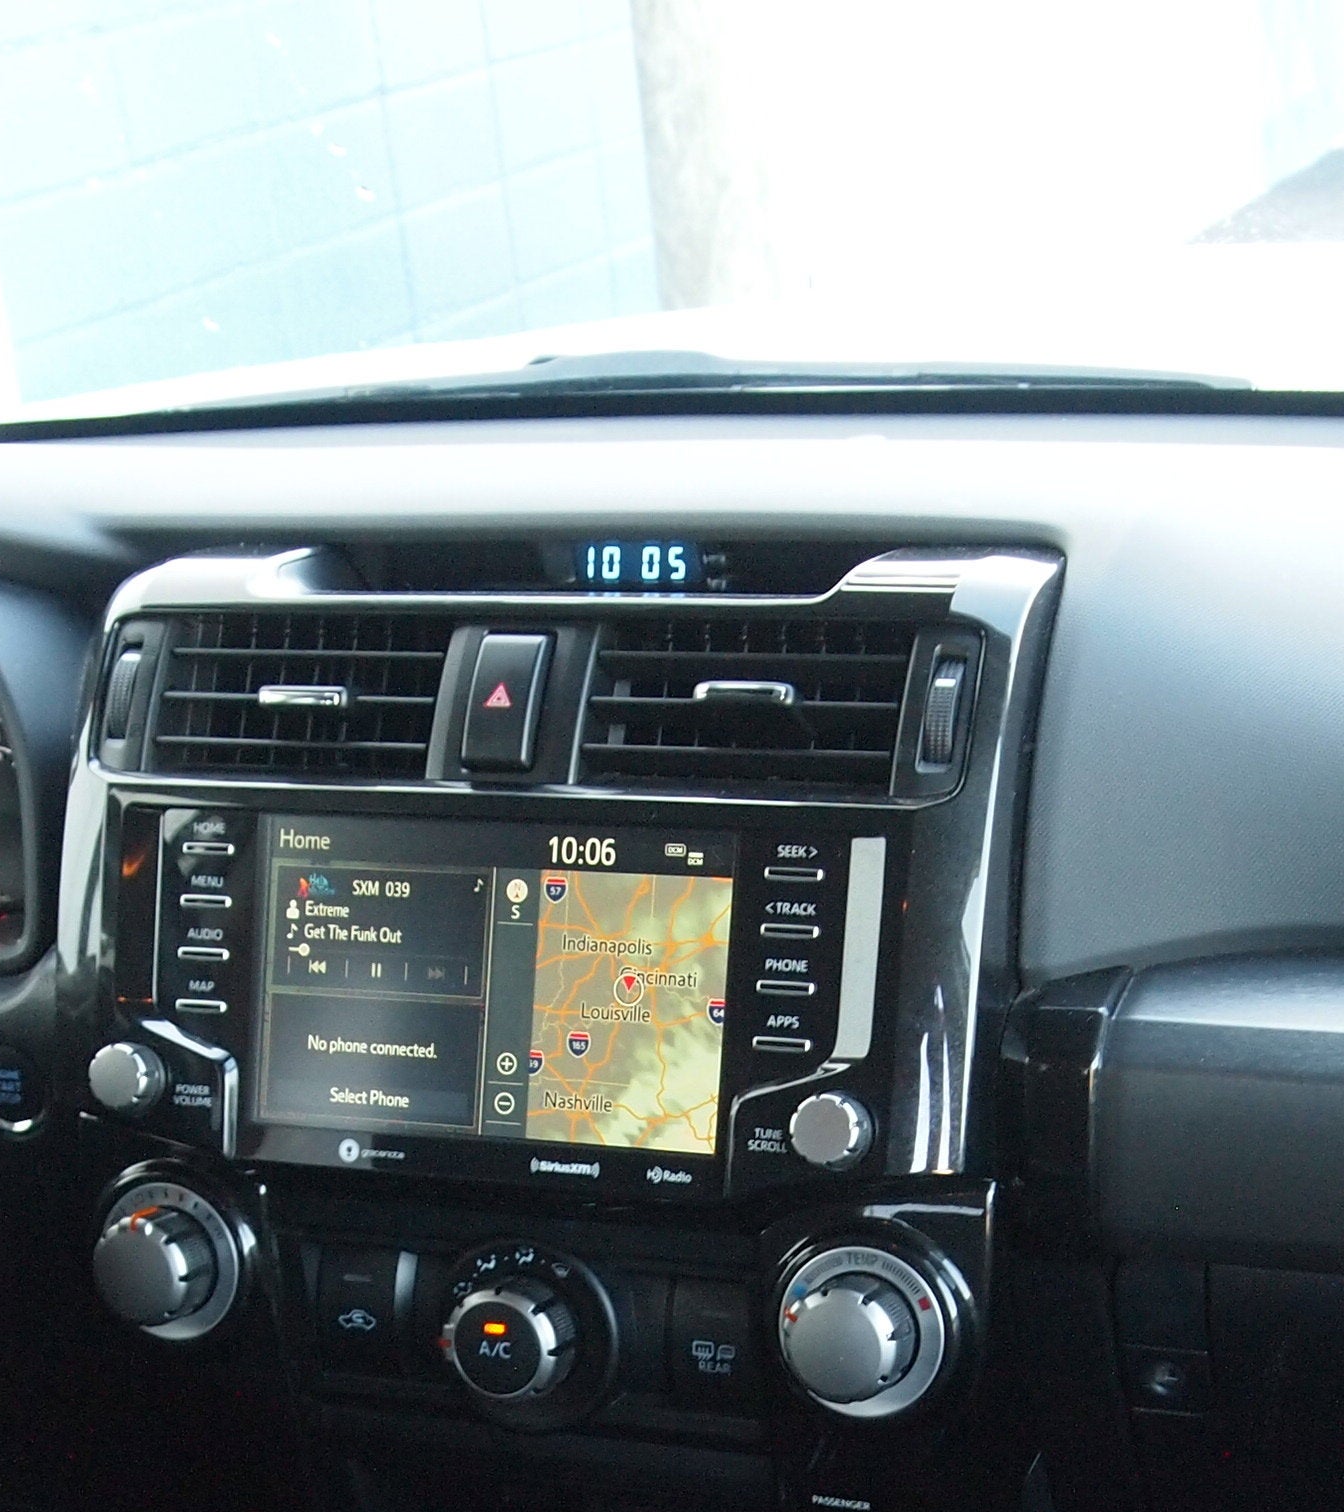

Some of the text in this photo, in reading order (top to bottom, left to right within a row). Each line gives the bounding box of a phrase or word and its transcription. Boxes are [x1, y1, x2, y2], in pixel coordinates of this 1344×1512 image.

[193, 822, 226, 835] HOME
[279, 828, 331, 850] Home
[548, 836, 617, 866] 10:06
[776, 844, 807, 859] SEEK
[191, 875, 224, 888] MENU
[352, 879, 380, 897] SXM
[385, 880, 411, 898] 039
[549, 886, 562, 896] 57
[305, 900, 350, 918] Extreme
[510, 904, 521, 919] S
[776, 903, 817, 916] TRACK
[187, 928, 224, 940] AUDIO
[304, 923, 402, 944] Get The Funk Out
[562, 934, 653, 957] Indianapolis
[765, 958, 809, 972] PHONE
[188, 980, 215, 992] MAP
[581, 1003, 651, 1023] Louisville
[766, 1015, 800, 1029] APPS
[308, 1034, 438, 1059] No phone connected.
[329, 1087, 410, 1108] Select Phone
[544, 1091, 613, 1112] Nashville
[747, 1139, 787, 1154] SCROLL
[478, 1340, 512, 1360] A/C
